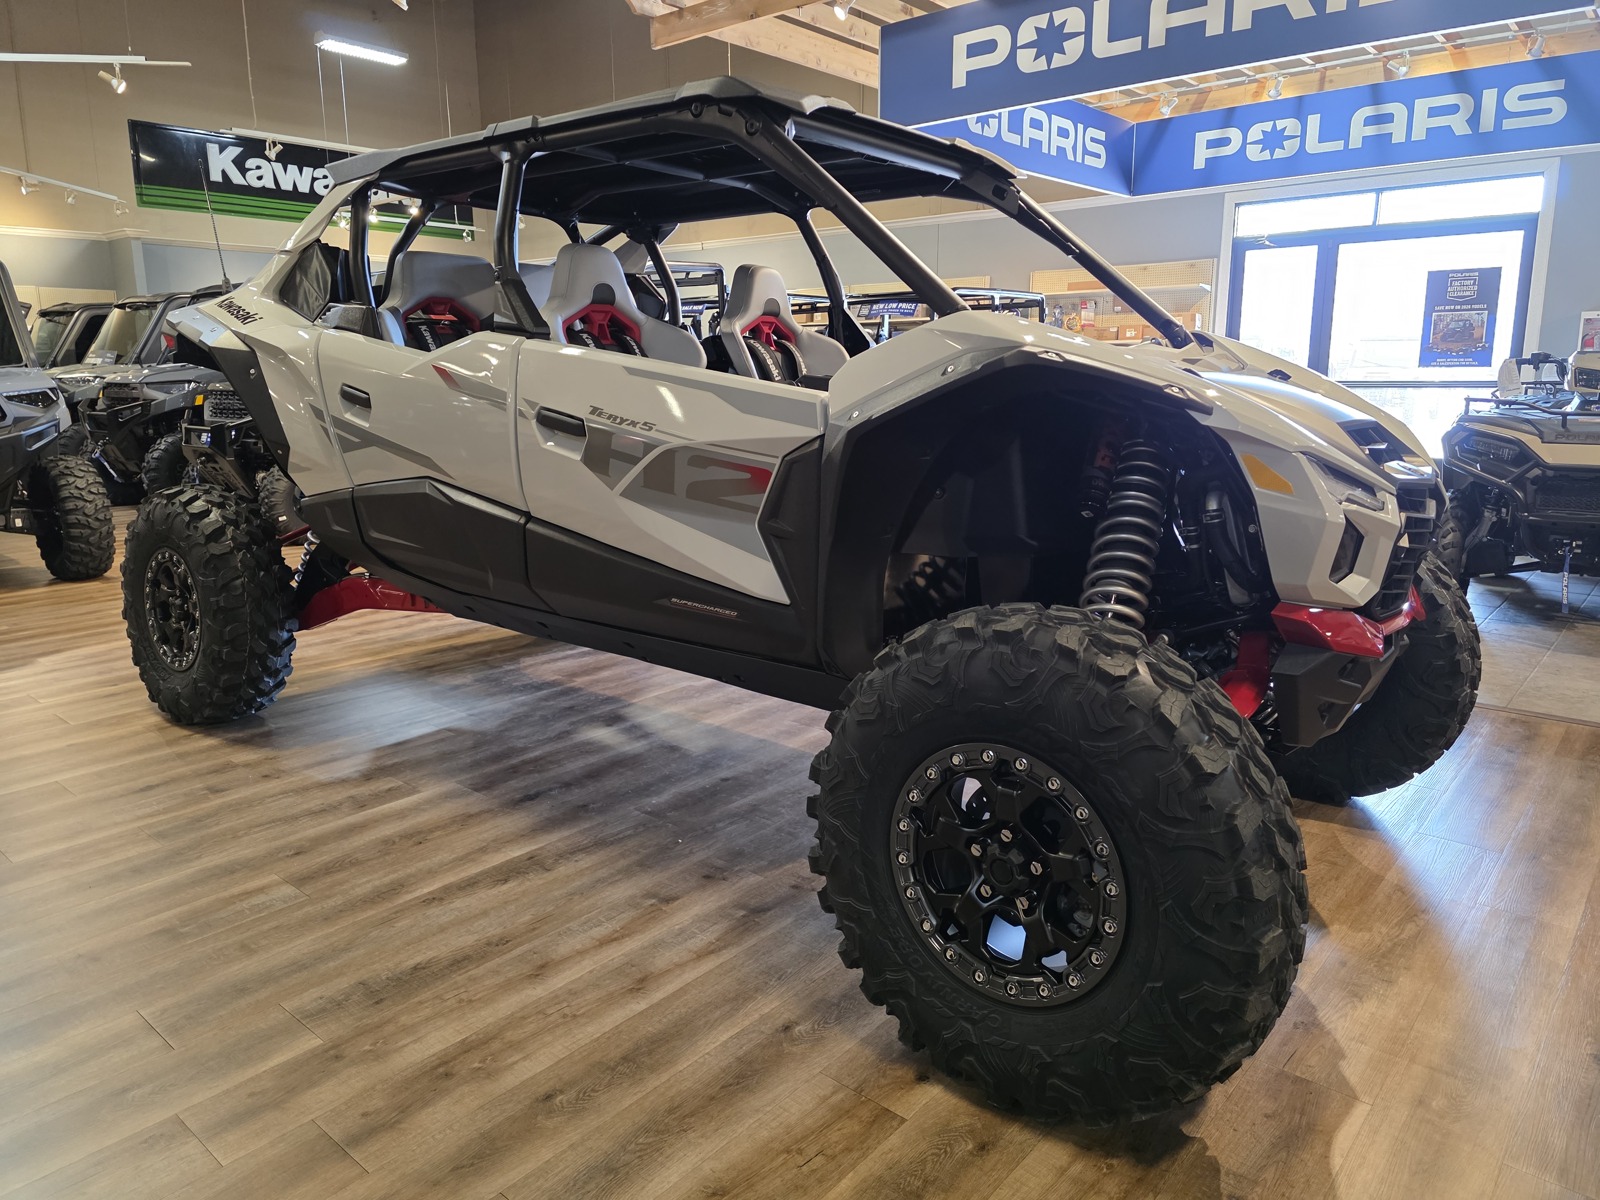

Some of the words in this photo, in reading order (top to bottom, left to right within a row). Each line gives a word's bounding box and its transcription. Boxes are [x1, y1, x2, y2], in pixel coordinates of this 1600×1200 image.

[1193, 79, 1568, 170] POLARIS
[214, 296, 264, 326] Kawasaki
[748, 339, 782, 381] Kawasaki
[671, 597, 738, 616] SUPERCHARGED
